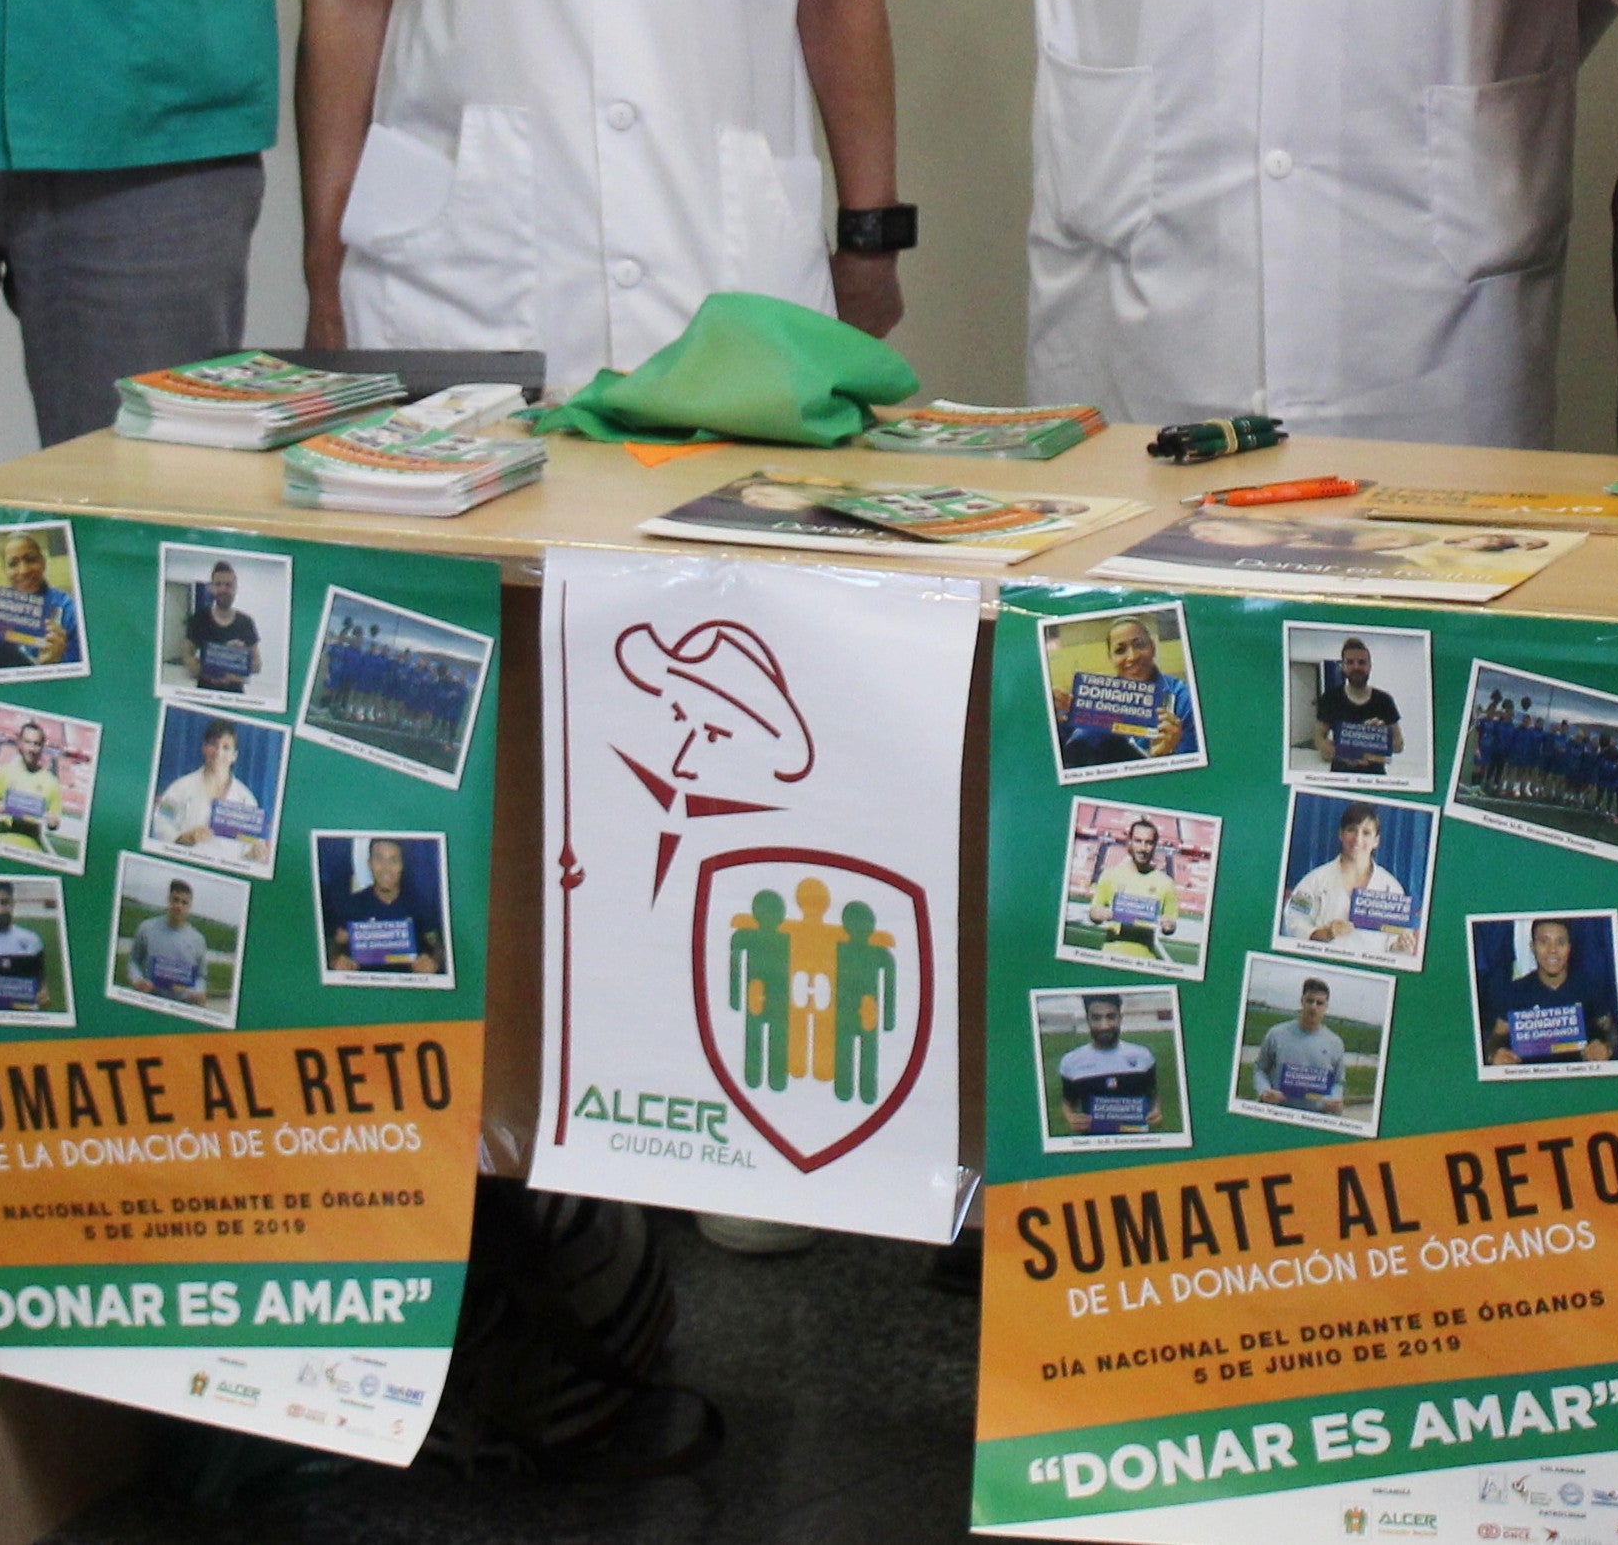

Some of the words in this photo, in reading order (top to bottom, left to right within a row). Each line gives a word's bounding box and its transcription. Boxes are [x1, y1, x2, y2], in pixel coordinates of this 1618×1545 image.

[1078, 684, 1154, 707] DONANTE
[202, 1052, 275, 1122] AL
[294, 1039, 452, 1116] RETO
[574, 1084, 729, 1145] ALCER
[17, 1141, 53, 1170] LA
[61, 1126, 221, 1167] DONACIÓN
[229, 1130, 264, 1158] DE
[274, 1122, 421, 1157] ÓRGANOS
[611, 1133, 693, 1160] CIUDAD
[701, 1144, 756, 1169] REAL
[3, 1199, 111, 1220] NACIONAL
[121, 1197, 163, 1215] DEL
[173, 1193, 275, 1213] DONANTE
[283, 1192, 312, 1210] DE
[321, 1187, 426, 1209] ÓRGANOS
[1017, 1174, 1304, 1281] SUMATE
[1337, 1161, 1420, 1240] AL
[84, 1225, 95, 1240] 5
[105, 1224, 133, 1240] DE
[143, 1221, 207, 1238] JUNIO
[216, 1220, 245, 1236] DE
[254, 1219, 306, 1234] 2019
[1067, 1283, 1108, 1318] DE
[1119, 1275, 1162, 1309] LA
[1171, 1245, 1358, 1303] DONACIÓN
[1368, 1245, 1409, 1278] DE
[1419, 1220, 1596, 1272] ÓRGANOS
[175, 1284, 240, 1326] ES
[1042, 1357, 1085, 1381] DÍA
[1098, 1338, 1229, 1372] NACIONAL
[1240, 1329, 1289, 1351] DEL
[1300, 1312, 1422, 1342] DONANTE
[1433, 1309, 1467, 1327] DE
[1478, 1290, 1606, 1322] ÓRGANOS
[1194, 1367, 1208, 1384] 5
[1221, 1361, 1253, 1381] DE
[1266, 1349, 1341, 1374] JUNIO
[1353, 1343, 1387, 1363] DE
[1398, 1335, 1462, 1358] 2019
[1310, 1407, 1391, 1463] ES
[1378, 1513, 1438, 1528] ALCER
